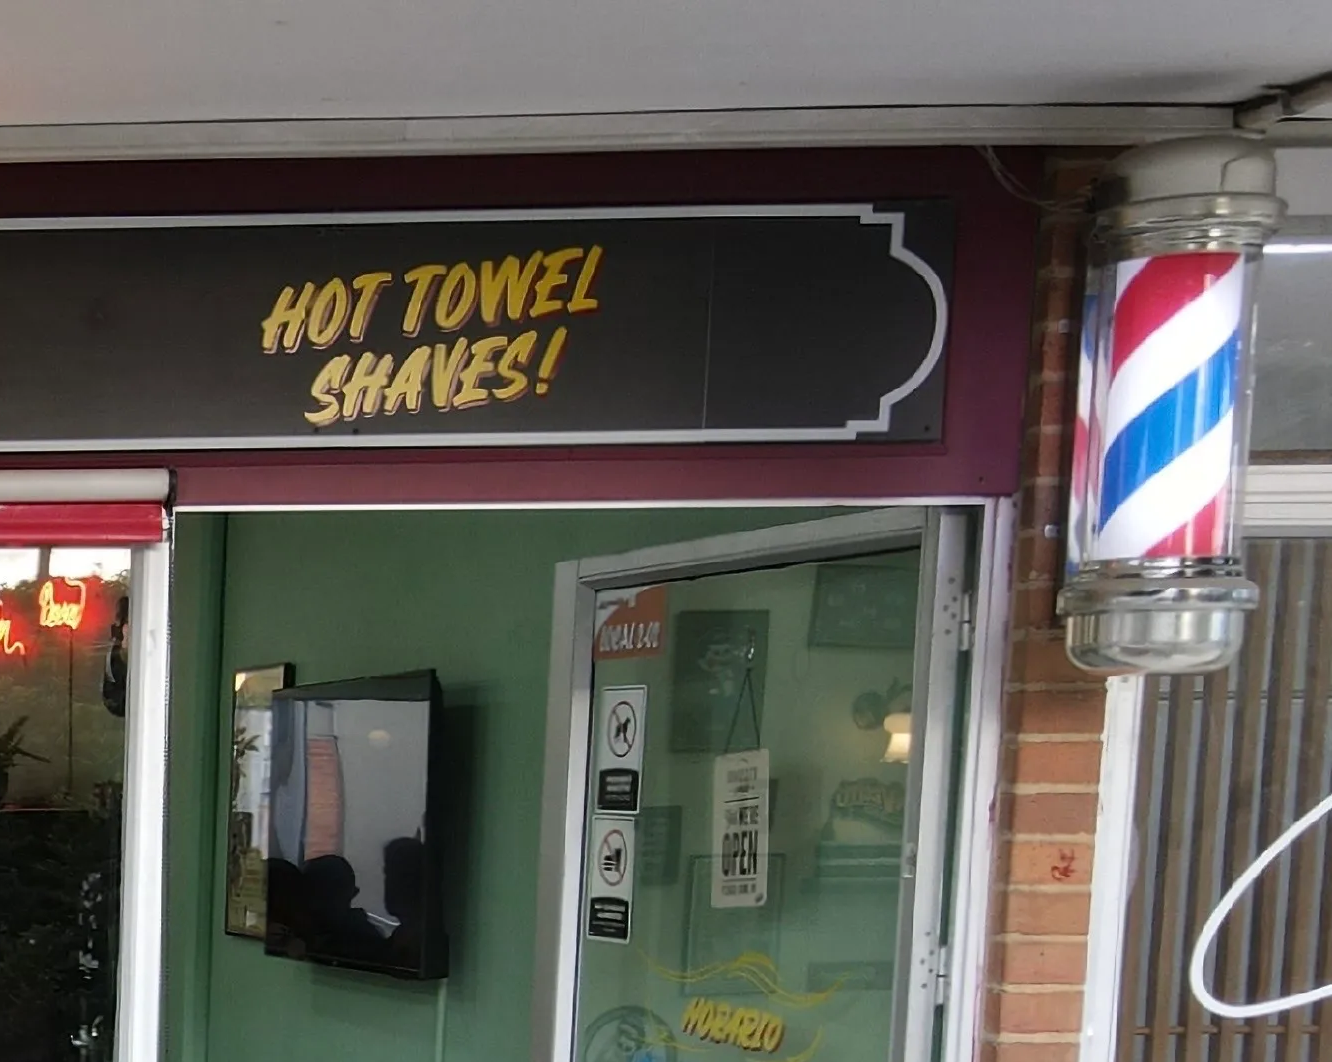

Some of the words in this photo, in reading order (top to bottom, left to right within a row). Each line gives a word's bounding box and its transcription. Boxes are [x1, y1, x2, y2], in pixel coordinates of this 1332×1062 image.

[260, 271, 392, 354] HOT
[401, 244, 604, 339] TOWEL
[303, 325, 569, 428] SHAVES!
[721, 830, 759, 877] OPEN
[681, 997, 785, 1054] HORARIO
